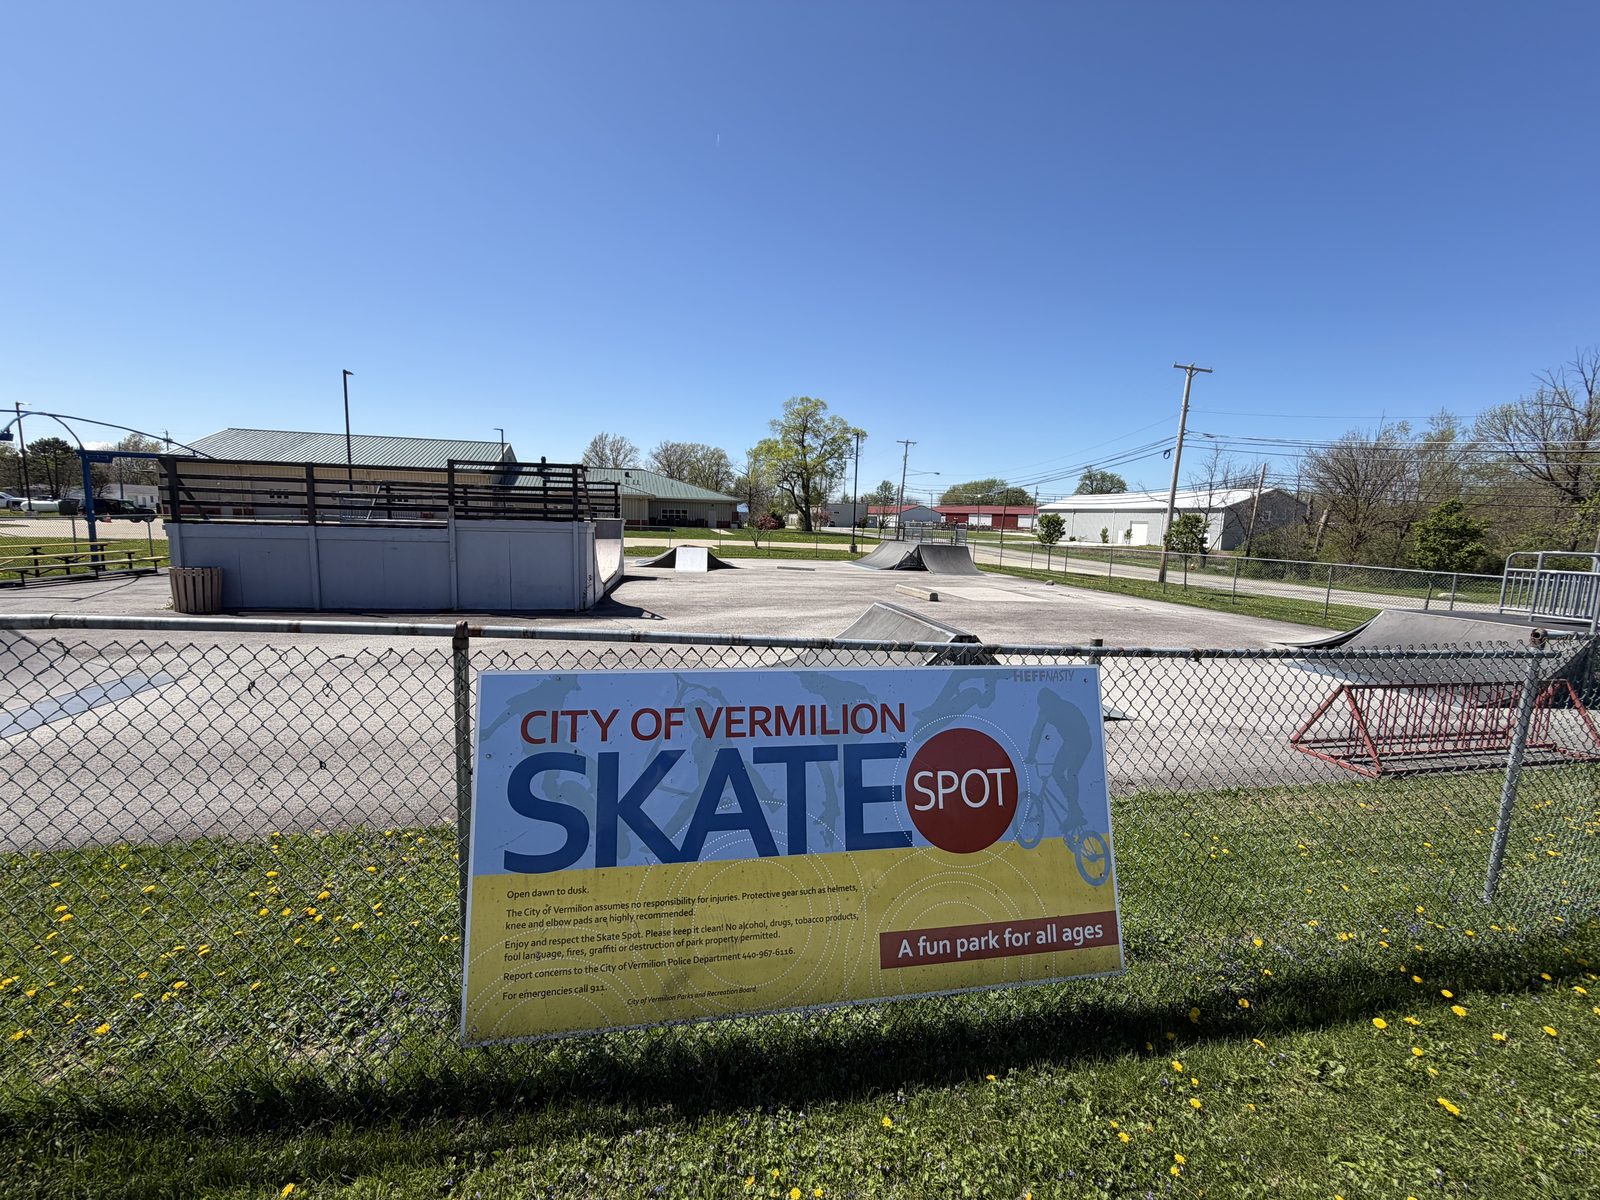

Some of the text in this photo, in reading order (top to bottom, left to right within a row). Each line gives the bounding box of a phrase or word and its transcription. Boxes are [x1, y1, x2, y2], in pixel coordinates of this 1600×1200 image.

[521, 703, 905, 744] CITY OF VERMILION
[504, 742, 1010, 874] SKATE SPOT
[506, 908, 522, 918] The
[524, 907, 540, 917] City
[542, 906, 551, 914] of
[553, 903, 592, 914] Vermilion
[595, 903, 629, 911] assumes
[643, 896, 696, 908] responsibility
[698, 895, 709, 904] for
[710, 895, 740, 904] injuries.
[742, 891, 780, 900] Protective
[782, 890, 798, 899] gear
[800, 887, 816, 895] such
[827, 884, 858, 893] helmets,
[507, 891, 530, 899] Open
[532, 888, 555, 897] dawn
[568, 886, 589, 895] dusk.
[505, 940, 529, 950] Enjoy
[531, 938, 547, 947] and
[549, 936, 579, 946] respect
[581, 934, 595, 942] the
[597, 933, 620, 941] Skate
[622, 931, 643, 941] Spot.
[645, 929, 671, 938] Please
[673, 927, 692, 936] keep
[701, 922, 724, 932] clean!
[726, 922, 737, 931] No
[738, 920, 768, 931] alcohol,
[770, 918, 793, 928] drugs,
[795, 916, 824, 925] tobacco
[825, 913, 859, 923] products,
[506, 922, 527, 930] knee
[528, 920, 544, 928] and
[546, 918, 571, 927] elbow
[573, 916, 592, 927] pads
[609, 913, 634, 923] highly
[636, 909, 696, 919] recommended.
[504, 953, 521, 962] foul
[522, 951, 564, 961] language,
[566, 948, 587, 957] fires,
[589, 946, 617, 957] graffiti
[629, 941, 674, 951] destruction
[676, 939, 684, 948] of
[686, 938, 703, 948] park
[705, 935, 738, 945] property
[740, 931, 780, 942] permitted.
[898, 924, 1103, 958] A fun park for all ages
[504, 971, 532, 982] Report
[535, 968, 572, 978] concerns
[585, 965, 598, 973] the
[600, 964, 616, 974] City
[618, 962, 627, 971] of
[628, 960, 666, 970] Vermilion
[668, 958, 691, 966] Police
[693, 952, 740, 964] Department
[742, 948, 795, 959] 440-967-6116.
[502, 985, 608, 1000] For emergencies call 911.
[641, 997, 647, 1005] of
[648, 995, 676, 1003] Vermilion
[707, 989, 738, 997] Recreation
